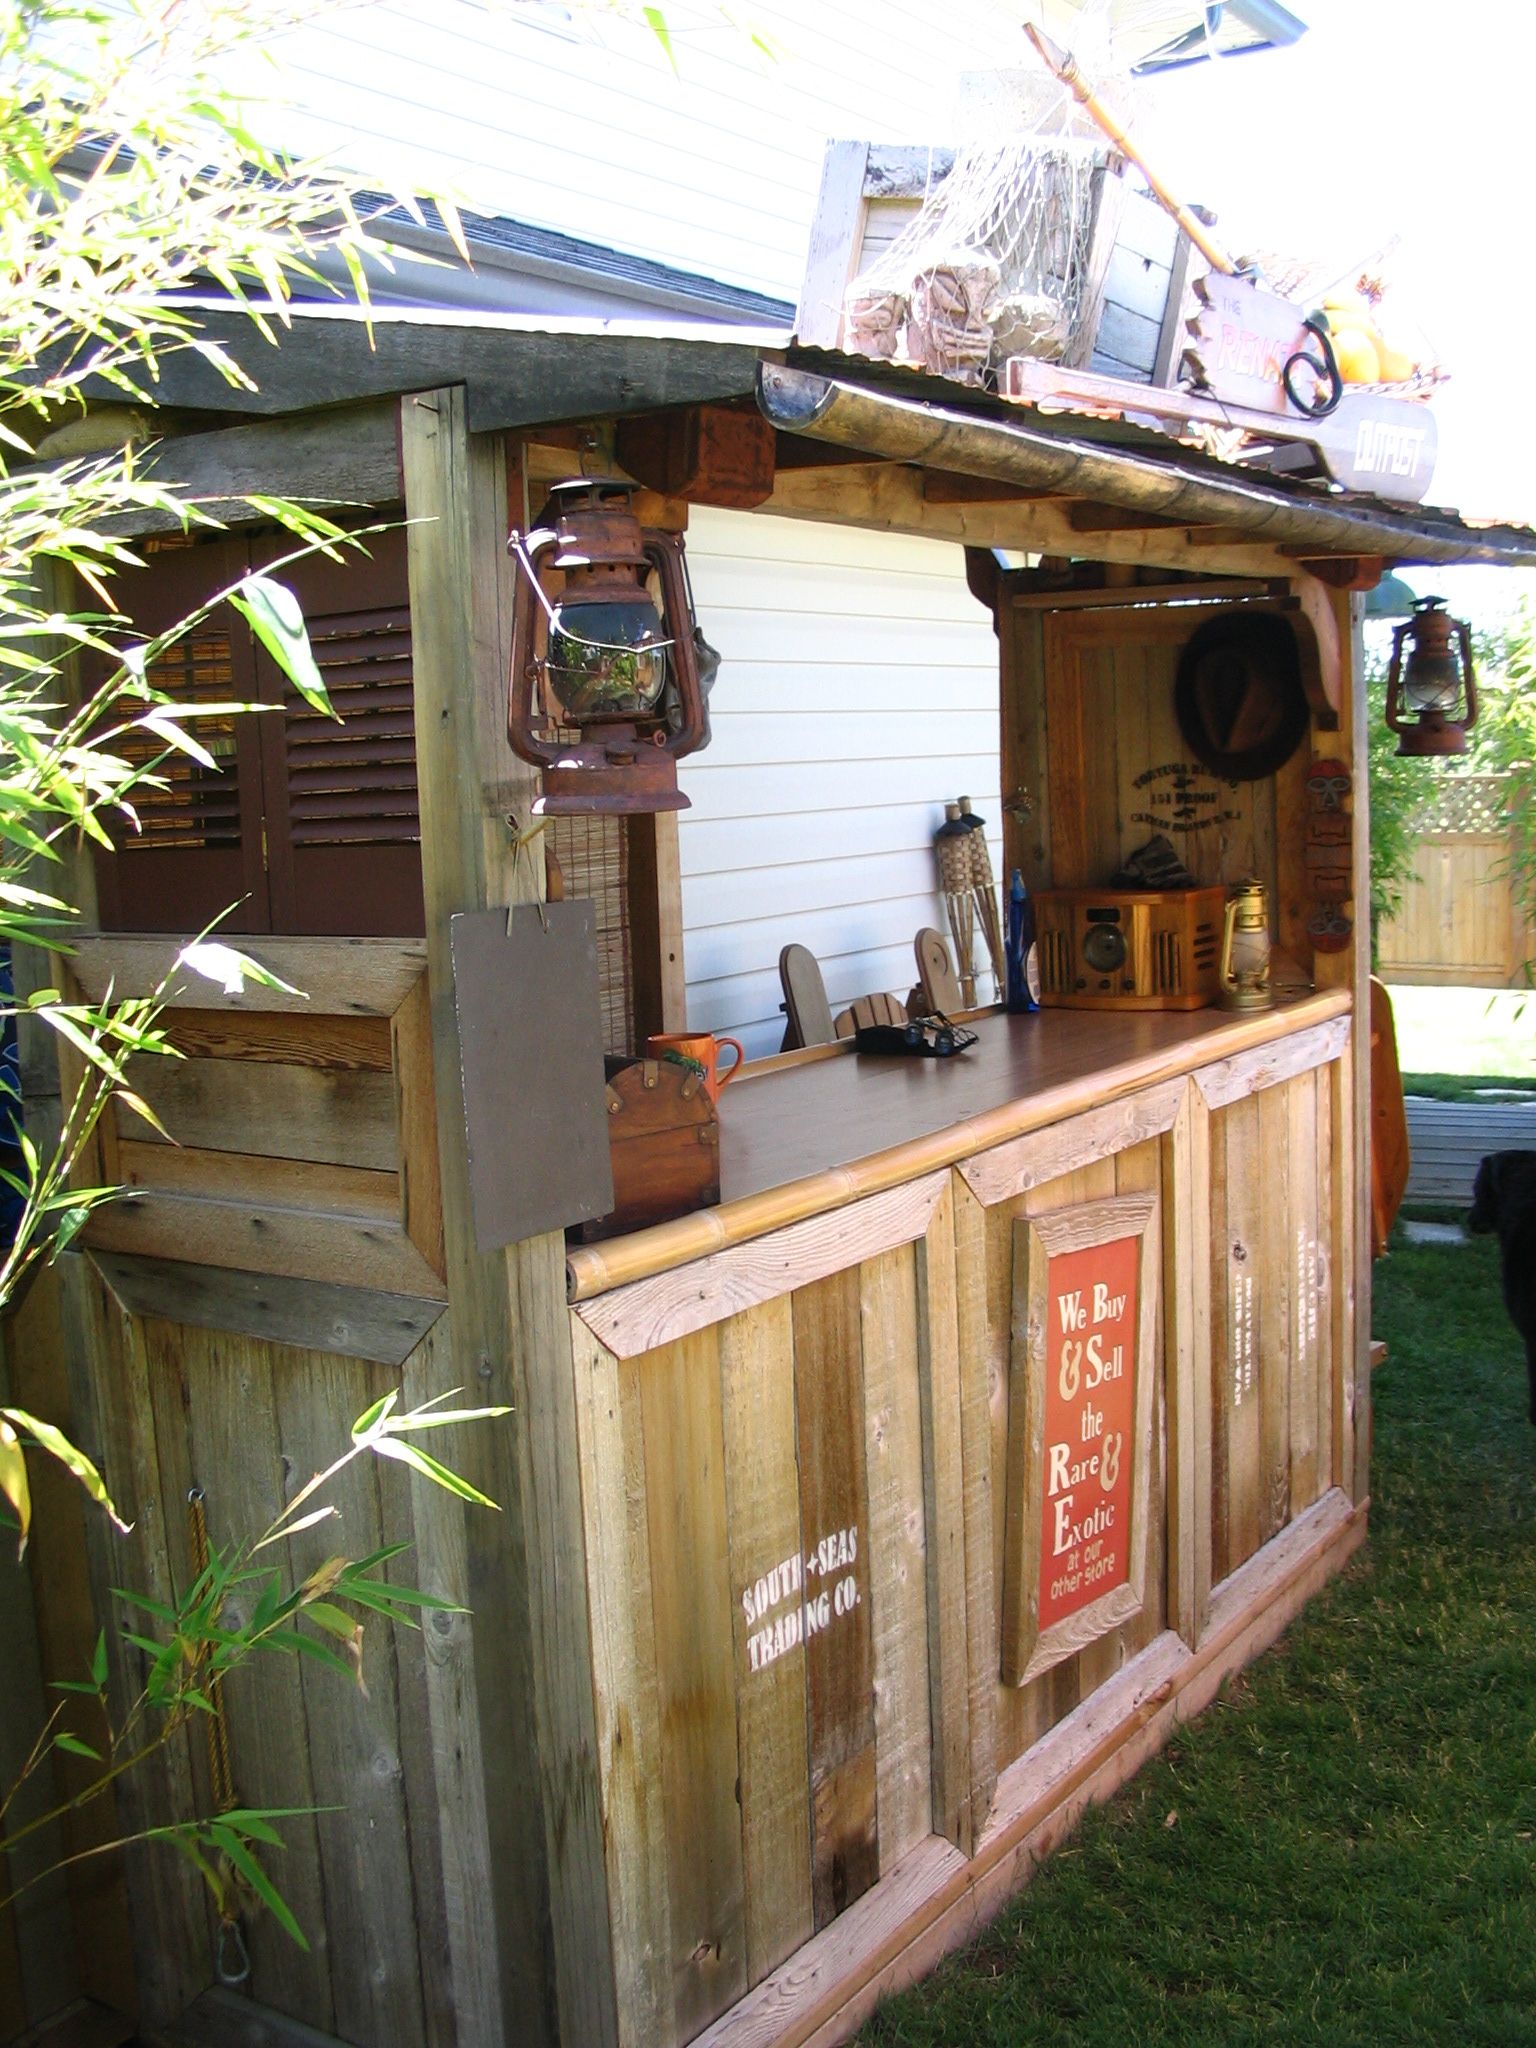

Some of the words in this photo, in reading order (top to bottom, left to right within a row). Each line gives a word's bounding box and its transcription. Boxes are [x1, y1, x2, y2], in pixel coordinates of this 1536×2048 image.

[1223, 296, 1241, 316] THE
[1353, 419, 1426, 479] OUTPOST
[1057, 1290, 1087, 1334] We
[1092, 1283, 1126, 1324] Buy
[1059, 1339, 1083, 1402] &
[1085, 1334, 1123, 1389] Sell
[1081, 1402, 1103, 1442] the
[1048, 1443, 1099, 1496] Rare
[1100, 1432, 1122, 1492] &
[818, 1526, 858, 1576] SEAS
[1053, 1495, 1115, 1556] Exotic
[1051, 1572, 1083, 1600] other
[1085, 1553, 1115, 1586] store
[1067, 1550, 1080, 1572] at
[1084, 1539, 1103, 1564] our
[746, 1591, 830, 1673] TRADING
[834, 1576, 862, 1617] CO.
